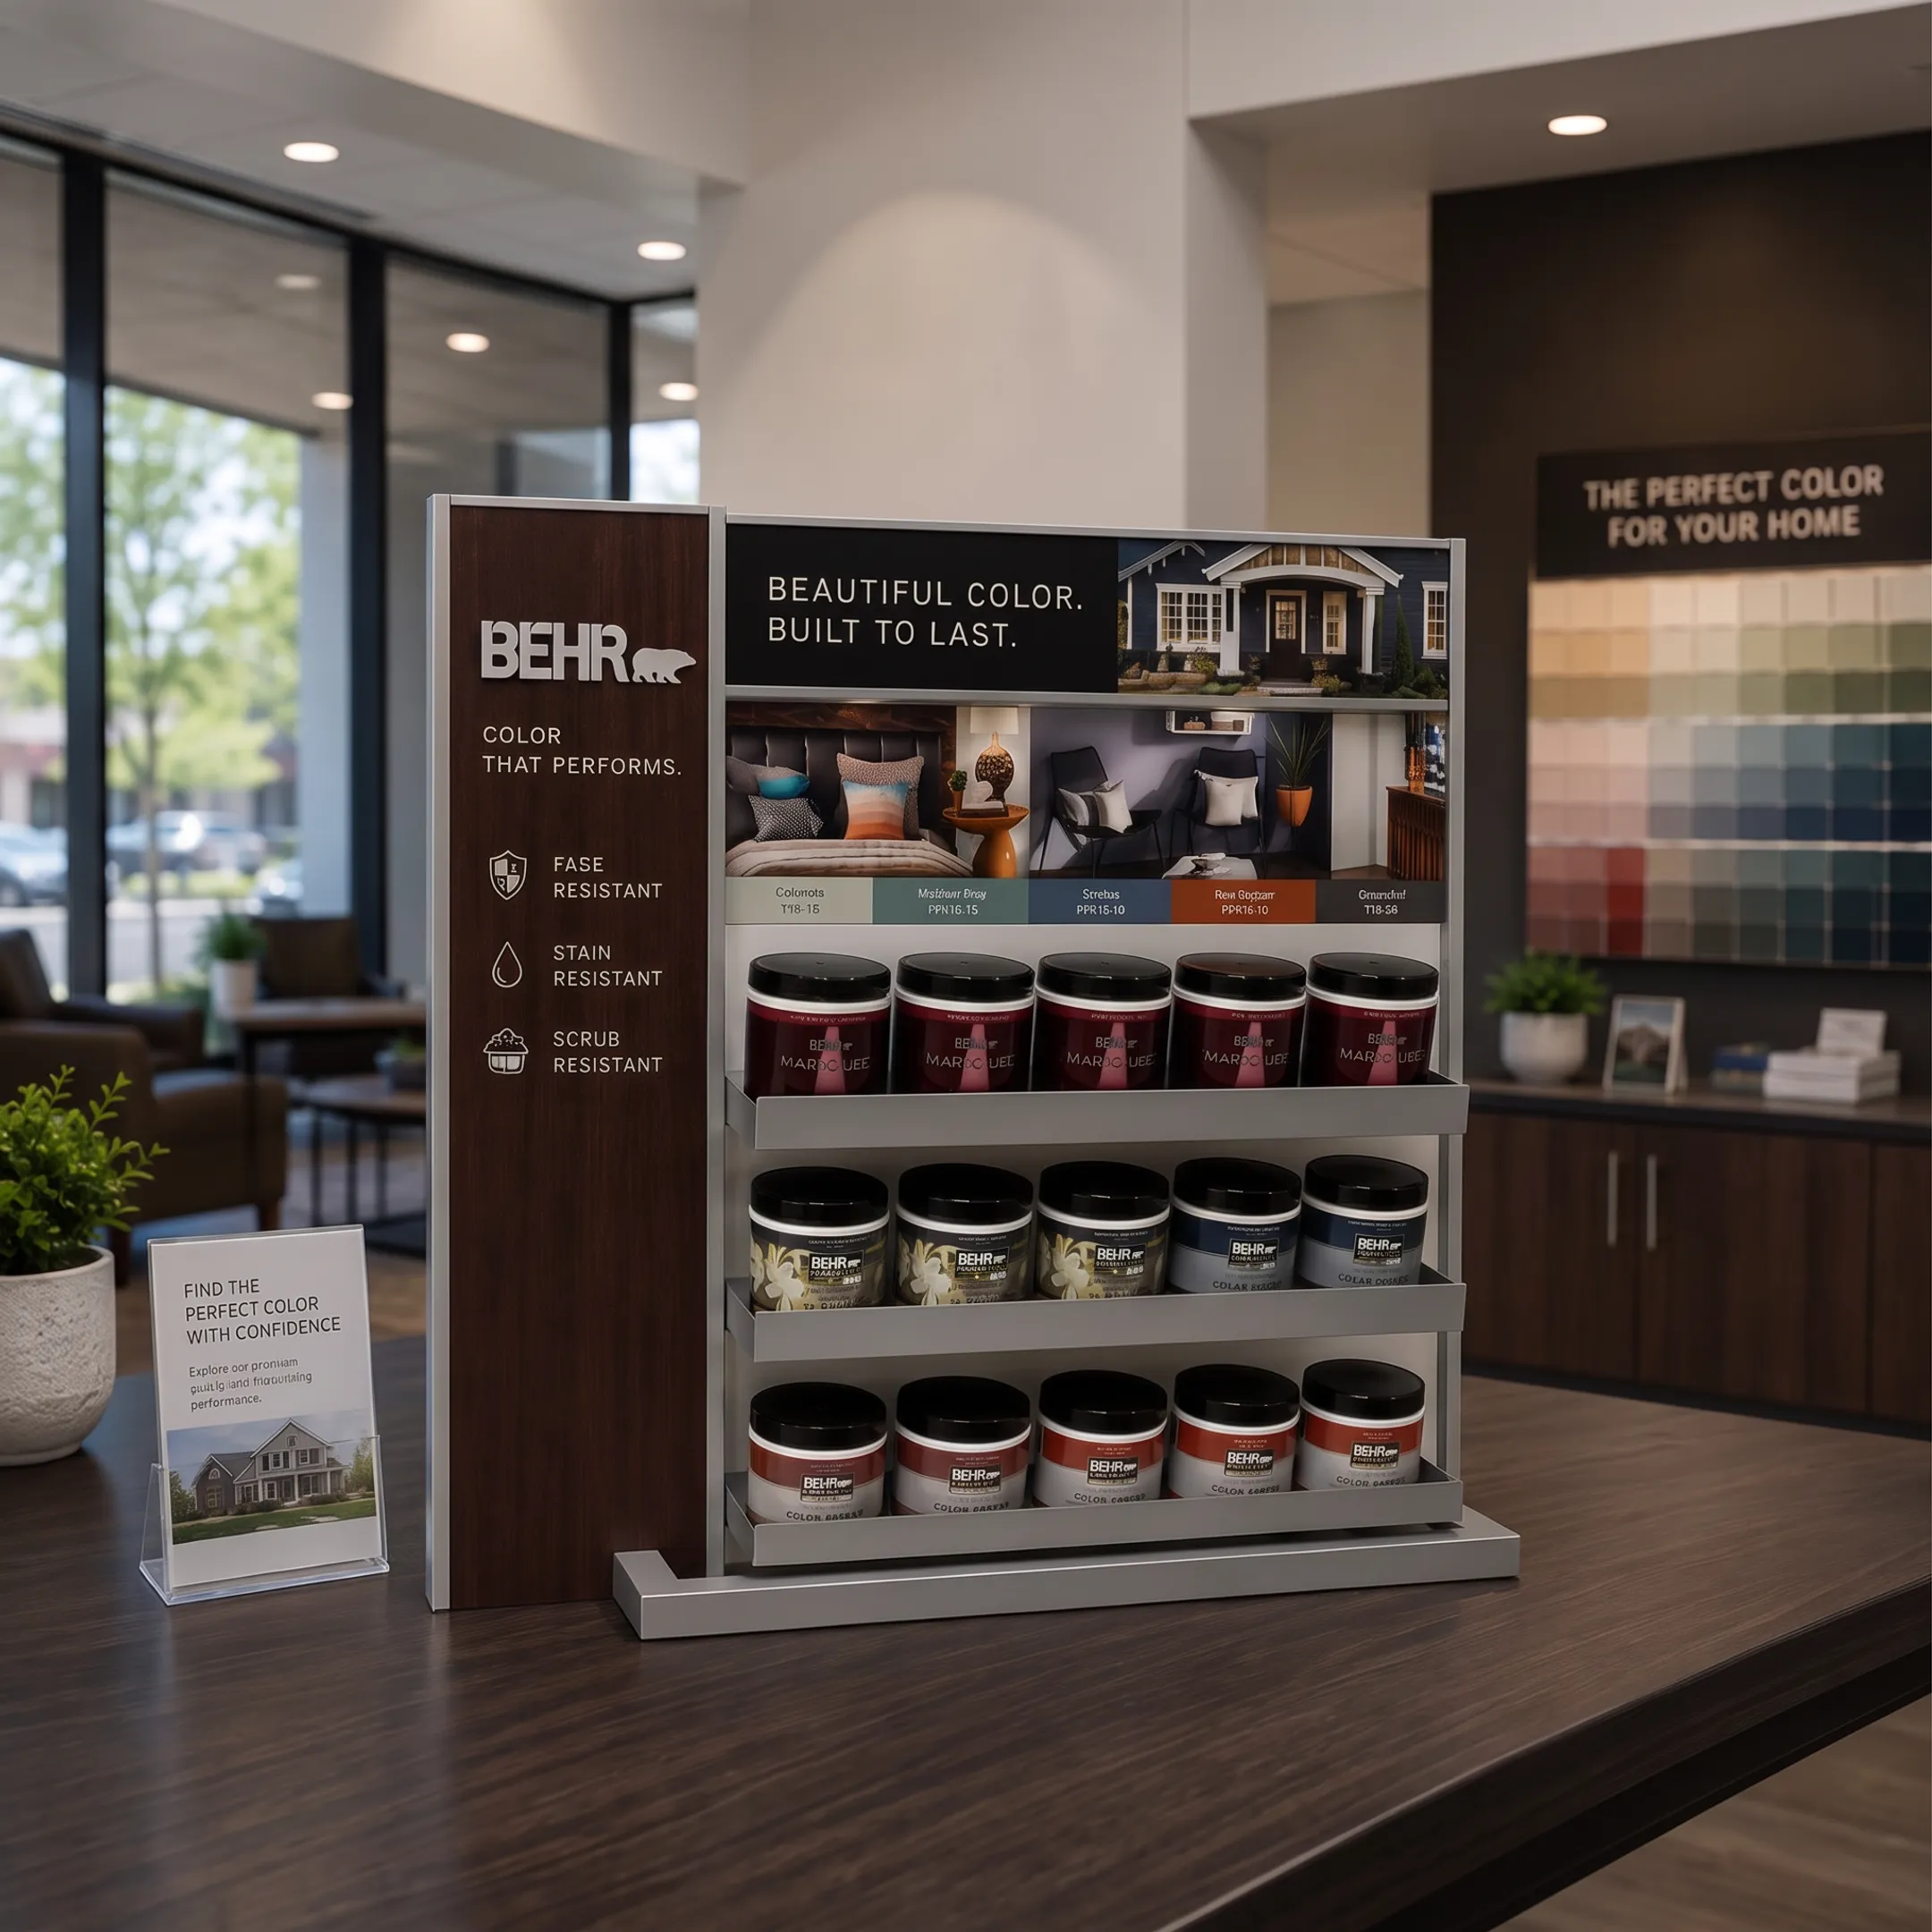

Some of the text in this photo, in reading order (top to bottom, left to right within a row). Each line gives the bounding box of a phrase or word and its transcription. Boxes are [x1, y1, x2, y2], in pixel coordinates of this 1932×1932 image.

[1583, 464, 1885, 511] THE PERFECT COLOR
[1607, 504, 1861, 548] FOR YOUR HOME
[768, 576, 1083, 610] BEAUTIFUL COLOR.
[768, 617, 1017, 648] BUILT TO LAST.
[480, 620, 631, 682] BEHR
[482, 726, 562, 745] COLOR
[482, 755, 682, 775] THAT PERFORMS.
[554, 856, 605, 873] FASE
[554, 883, 663, 899] RESISTANT
[553, 945, 611, 961] STAIN
[554, 970, 663, 987] RESISTANT
[553, 1031, 620, 1047] SCRUB
[554, 1057, 663, 1073] RESISTANT
[1232, 1242, 1265, 1255] BEHR
[1357, 1237, 1390, 1250] BEHR
[958, 1252, 993, 1266] BEHR
[1097, 1248, 1131, 1260] BEHR
[811, 1257, 848, 1270] BEHR
[183, 1278, 260, 1299] FIND THE
[185, 1295, 319, 1322] PERFECT COLOR
[186, 1316, 341, 1344] WITH CONFIDENCE
[189, 1365, 229, 1377] Explore
[191, 1394, 262, 1412] performance.
[1227, 1452, 1259, 1464] BEHR
[1353, 1444, 1386, 1457] BEHR
[1089, 1460, 1124, 1472] BEHR
[952, 1469, 986, 1481] BEHR
